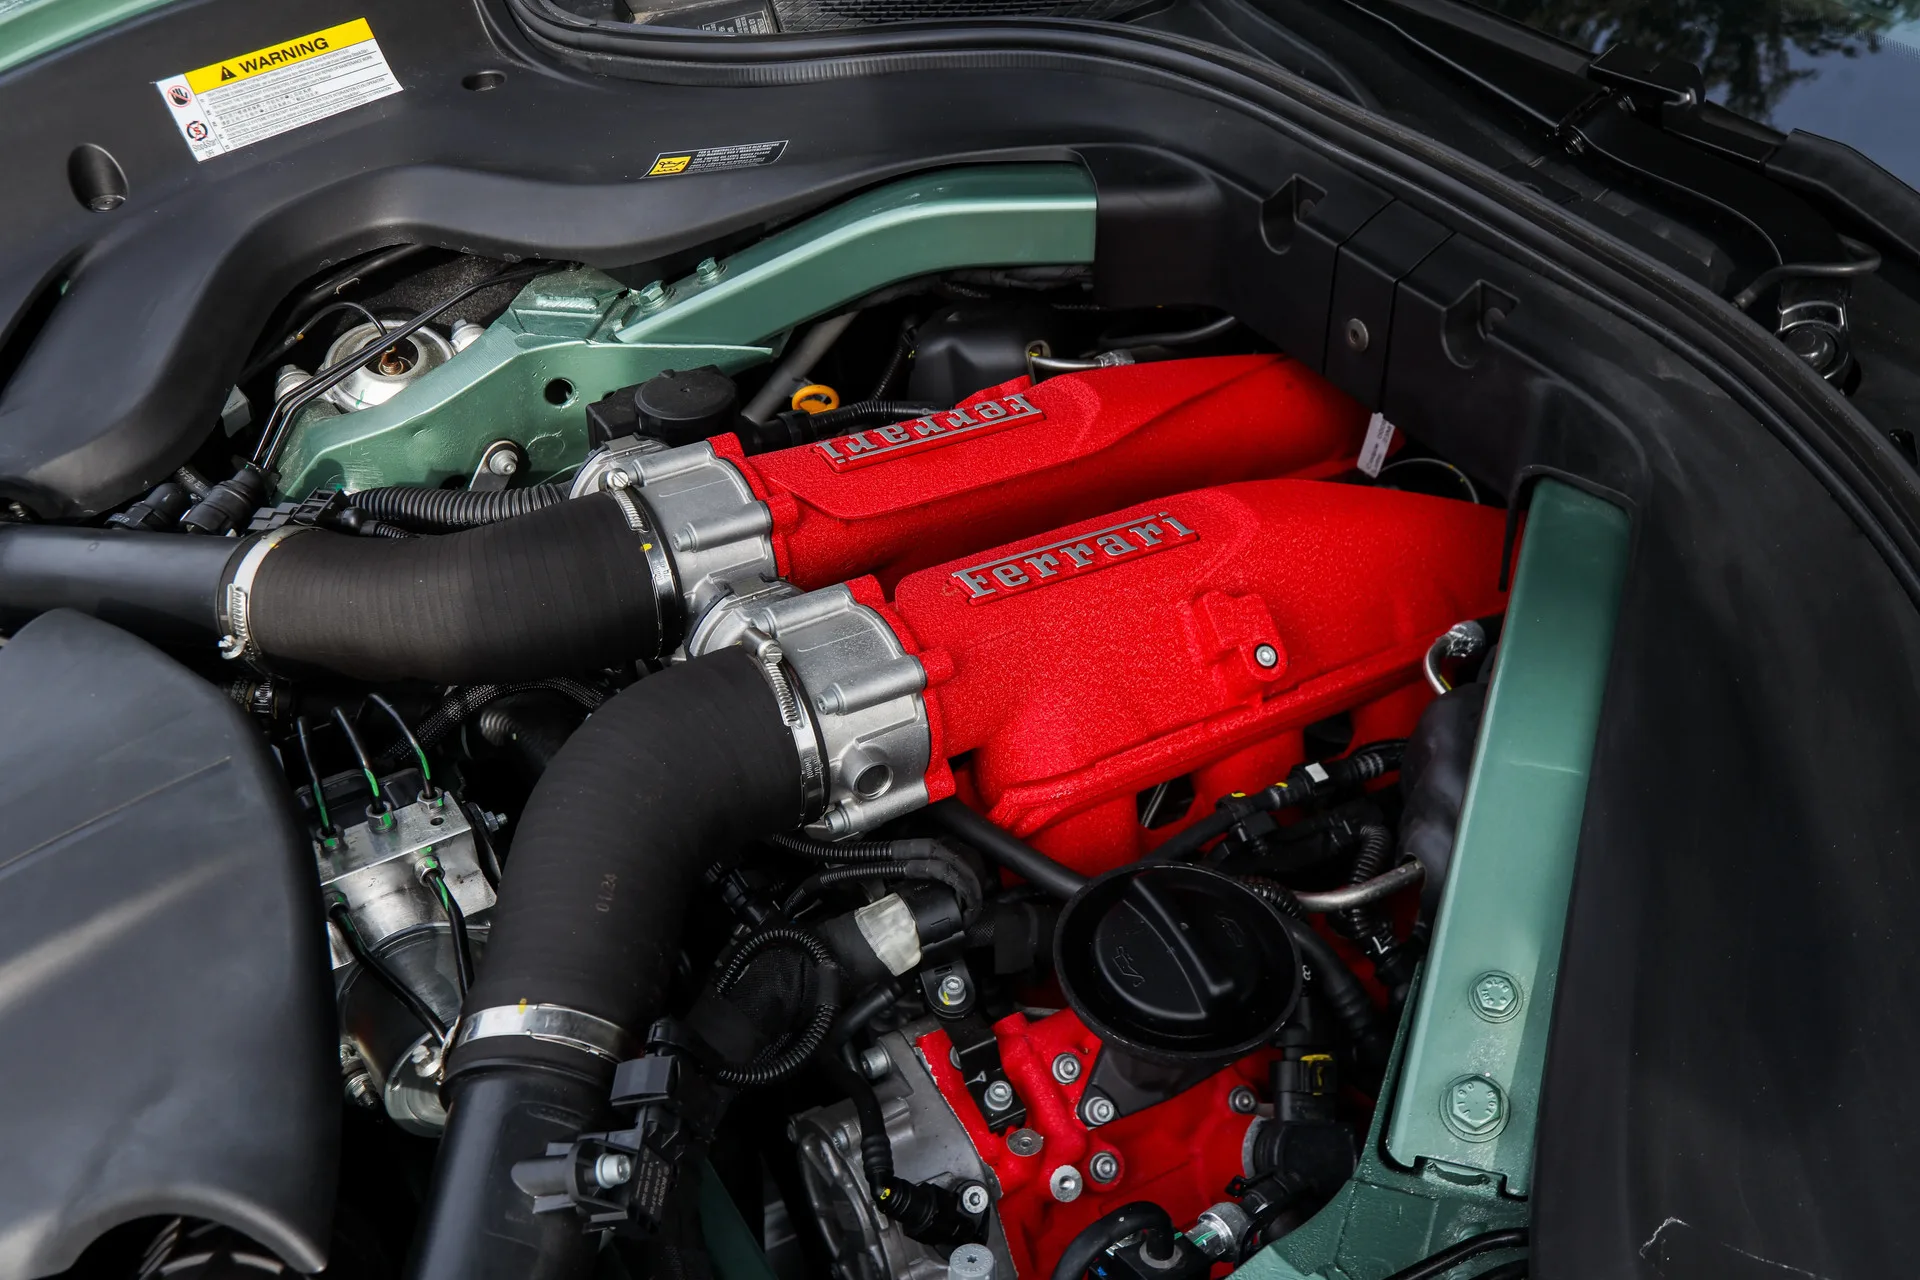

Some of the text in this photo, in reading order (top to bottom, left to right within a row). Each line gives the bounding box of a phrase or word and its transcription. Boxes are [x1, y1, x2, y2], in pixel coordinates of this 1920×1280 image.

[238, 37, 329, 73] WARNING
[815, 393, 1043, 464] Ferrari
[951, 511, 1195, 598] Ferrari
